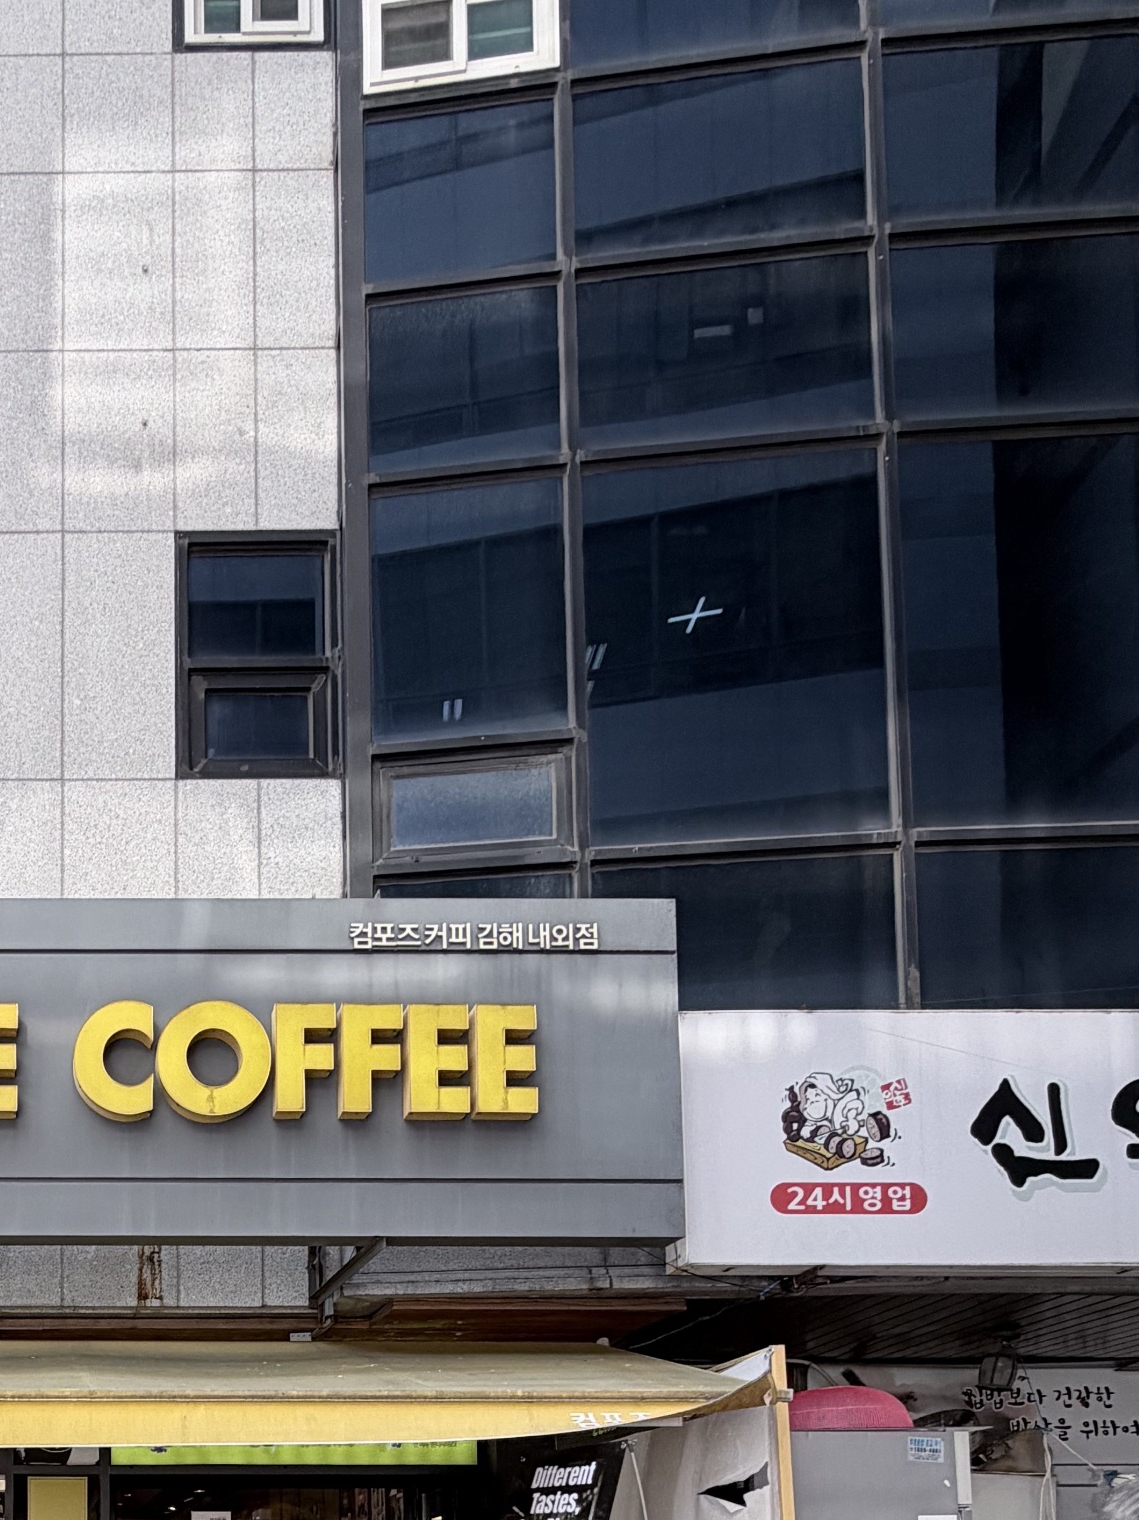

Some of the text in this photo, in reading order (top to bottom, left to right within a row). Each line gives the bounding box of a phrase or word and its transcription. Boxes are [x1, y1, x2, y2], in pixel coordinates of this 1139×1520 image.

[527, 922, 599, 950] 내외점
[72, 998, 540, 1123] COFFEE
[530, 1461, 597, 1489] Different
[530, 1490, 581, 1515] Tastes,
